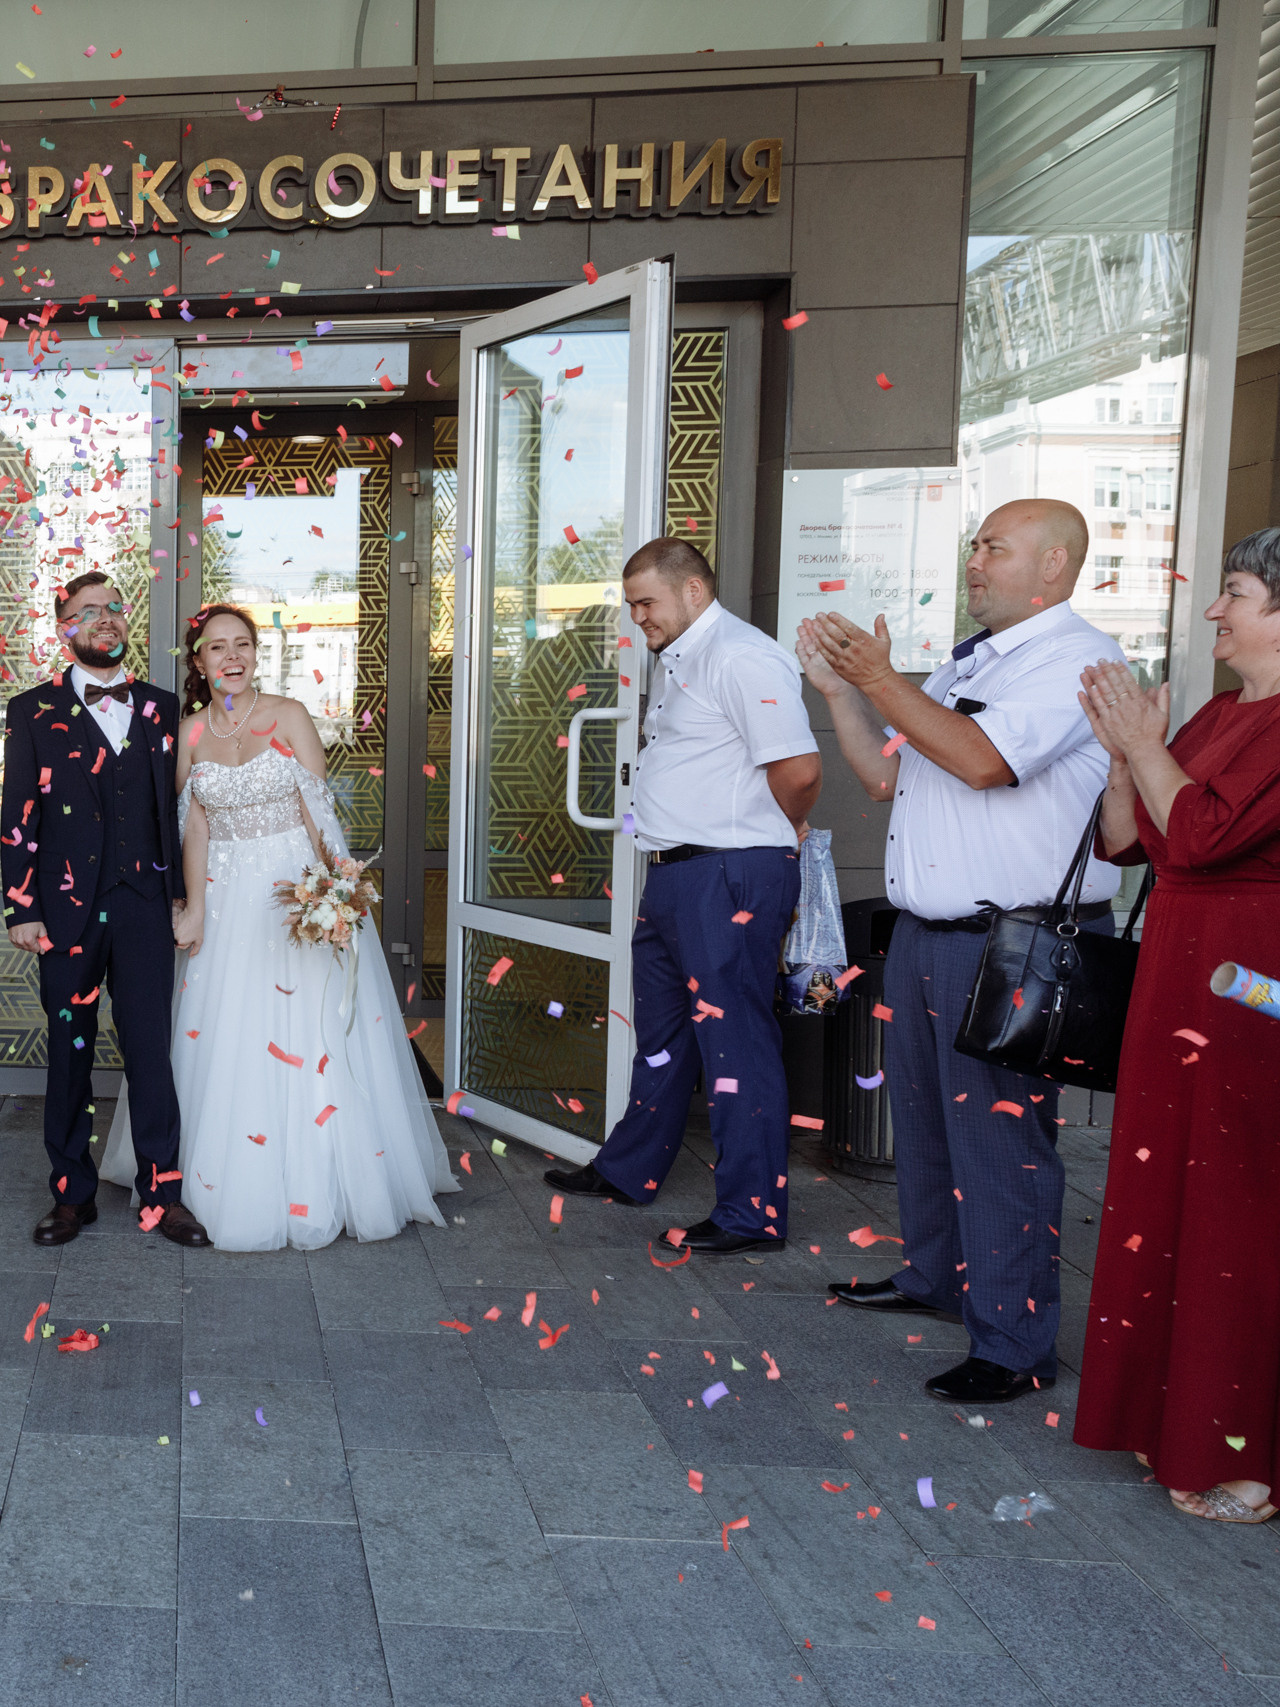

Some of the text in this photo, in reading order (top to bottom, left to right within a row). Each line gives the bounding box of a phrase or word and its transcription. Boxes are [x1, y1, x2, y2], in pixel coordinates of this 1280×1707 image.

[799, 523, 827, 531] Дворец
[797, 553, 885, 563] РЕЖИМ РАБОТЫ
[875, 569, 899, 579] 9:00
[911, 569, 938, 579] 18:00
[870, 588, 899, 598] 10:00
